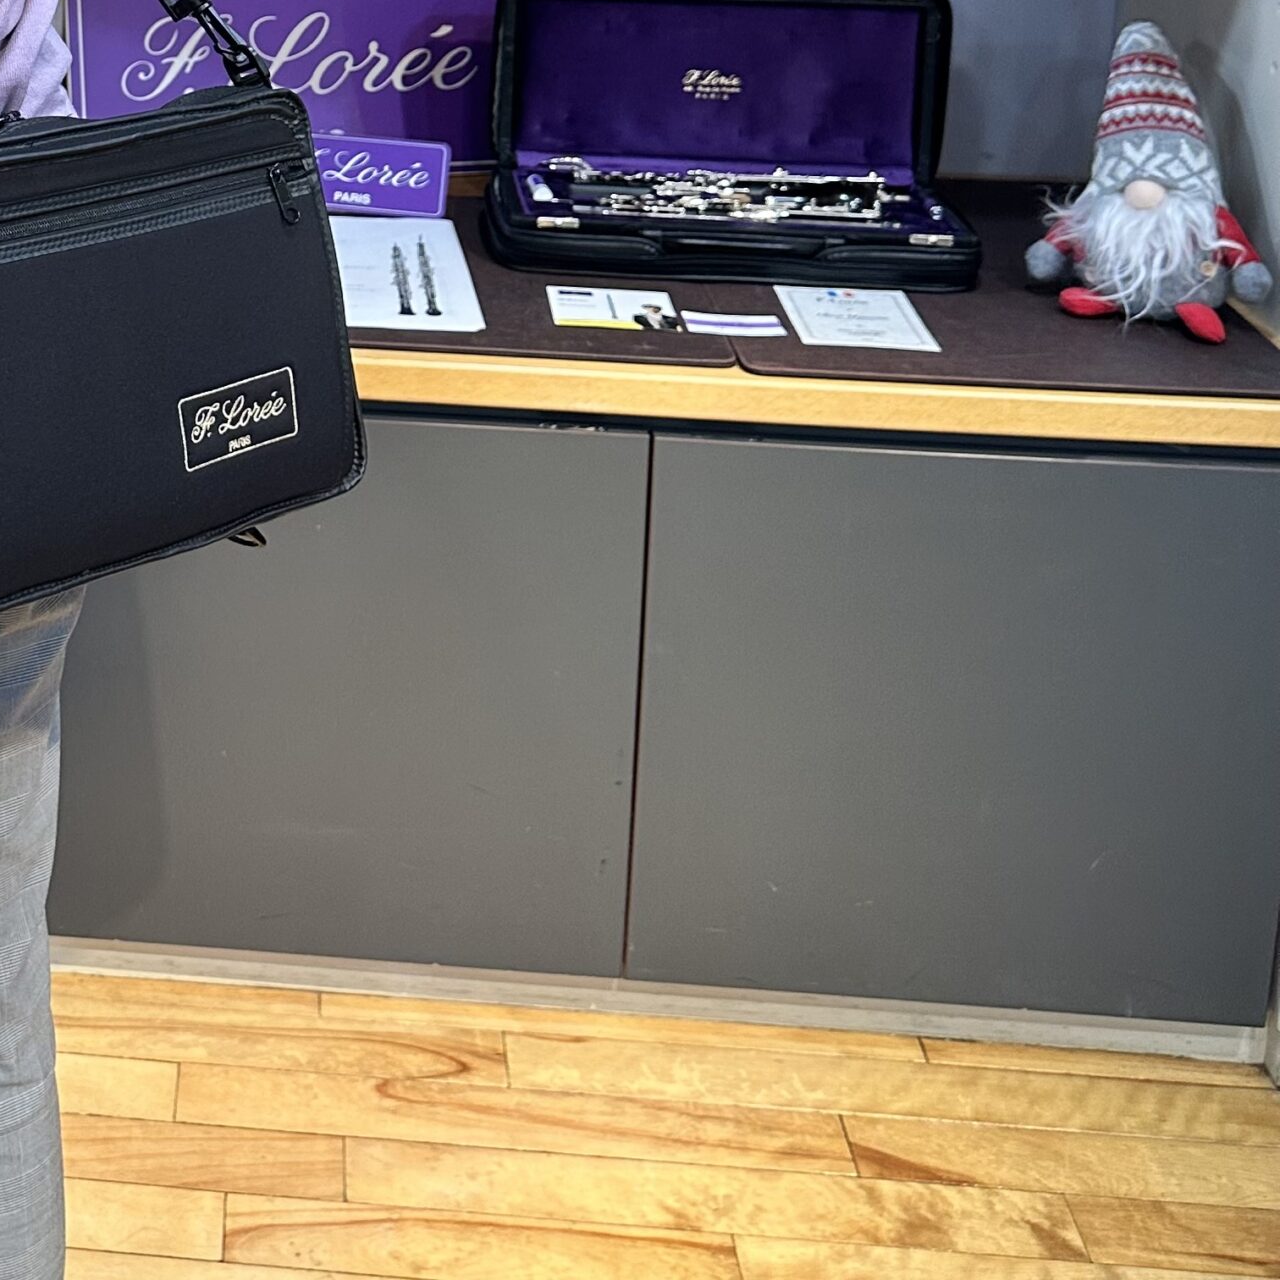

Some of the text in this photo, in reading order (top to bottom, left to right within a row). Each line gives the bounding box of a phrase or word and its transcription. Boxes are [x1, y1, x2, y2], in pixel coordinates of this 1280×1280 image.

[248, 11, 478, 95] Lorée
[322, 150, 430, 189] Lorée
[333, 191, 372, 205] PARIS
[218, 391, 287, 434] Lorée
[228, 434, 252, 452] PARIS
